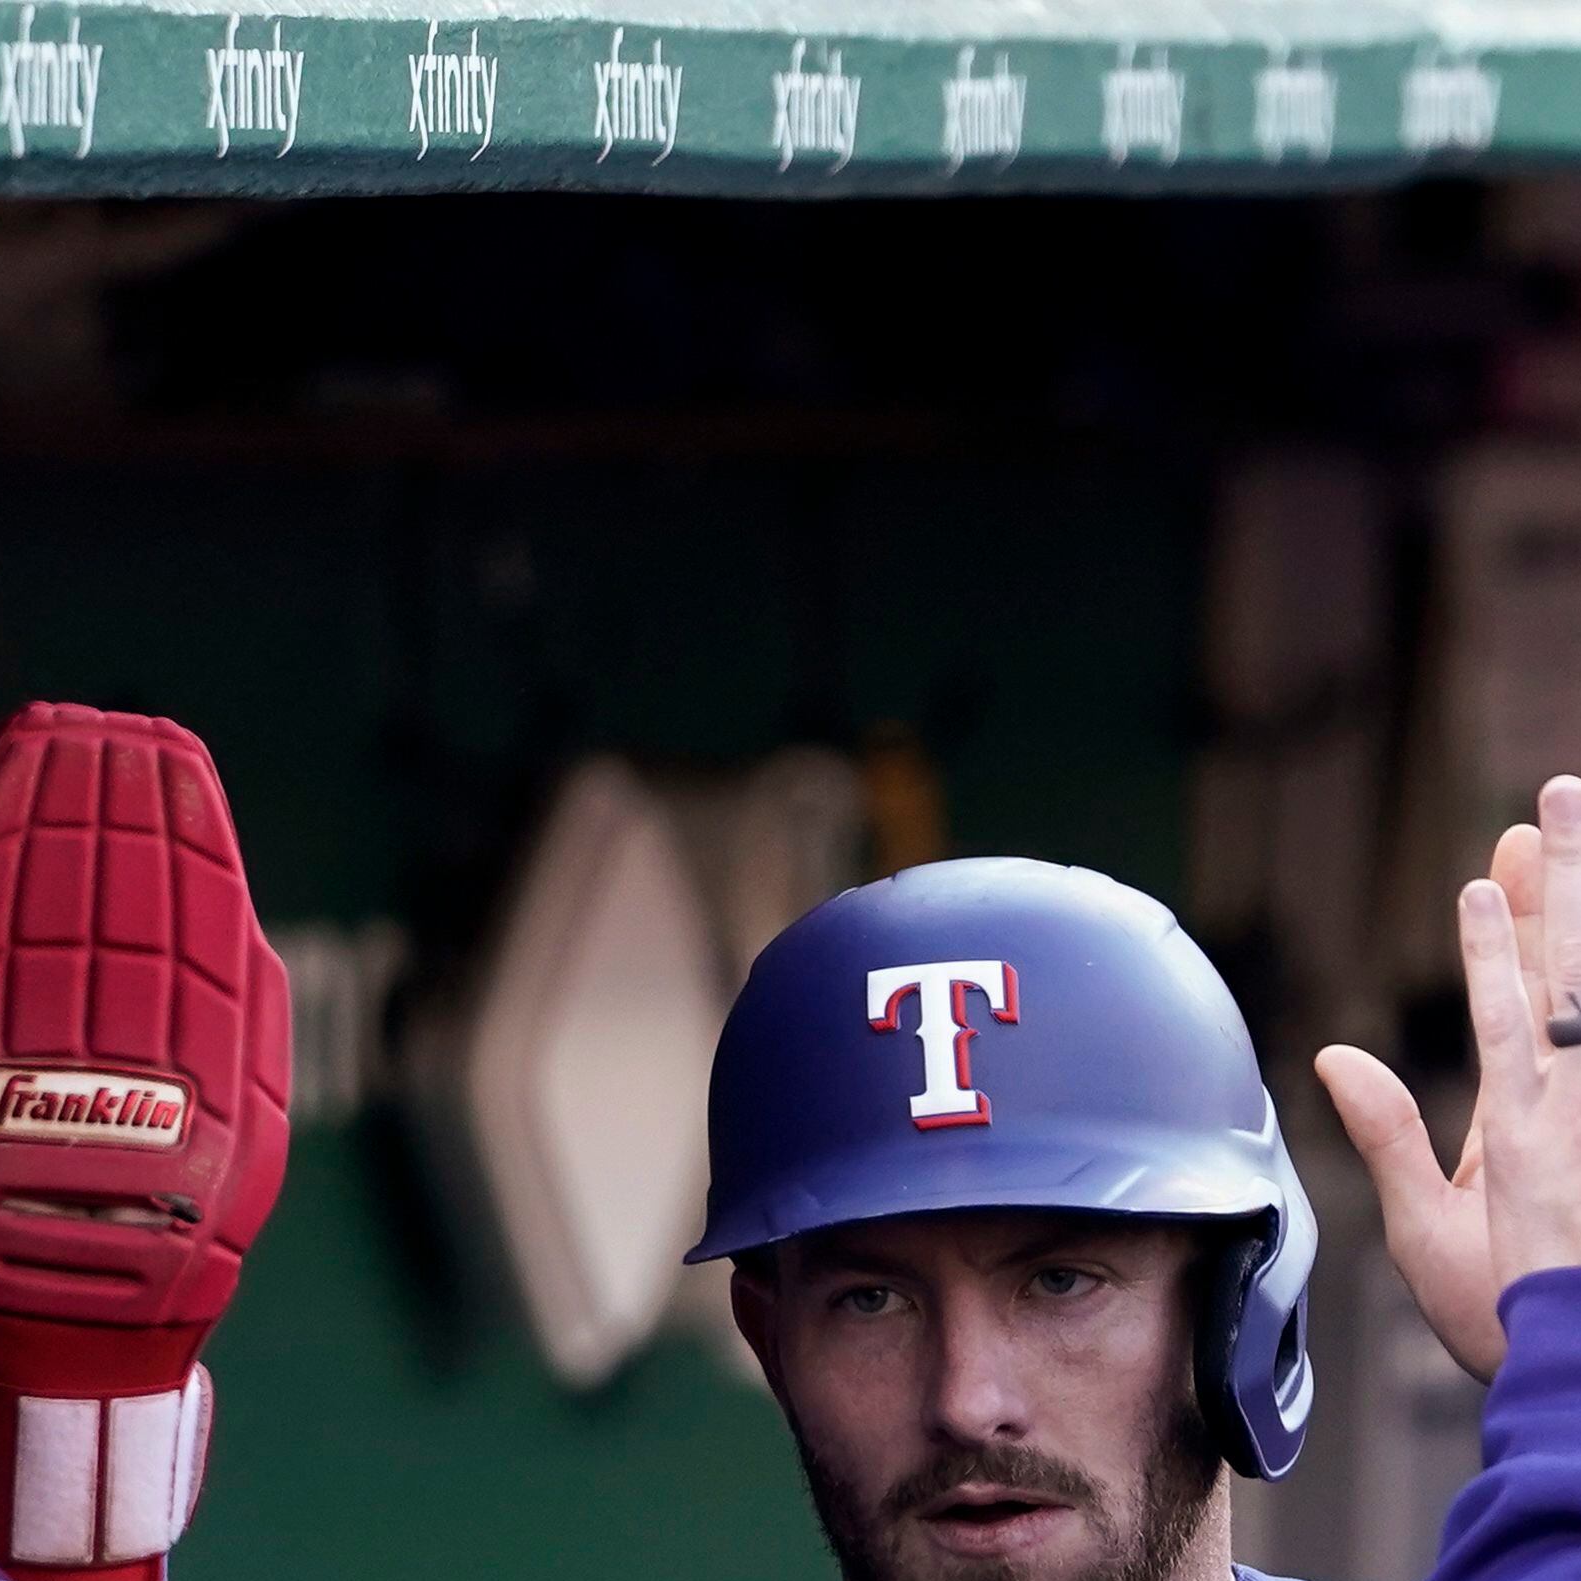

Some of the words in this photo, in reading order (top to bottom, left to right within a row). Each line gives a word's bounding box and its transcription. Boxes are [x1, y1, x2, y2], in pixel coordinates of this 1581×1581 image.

[206, 12, 304, 159] xfinity
[408, 19, 498, 162] xfinity
[593, 26, 682, 167] xfinity
[771, 37, 861, 174] xfinity
[942, 44, 1026, 177] xfinity
[867, 960, 1019, 1132] T
